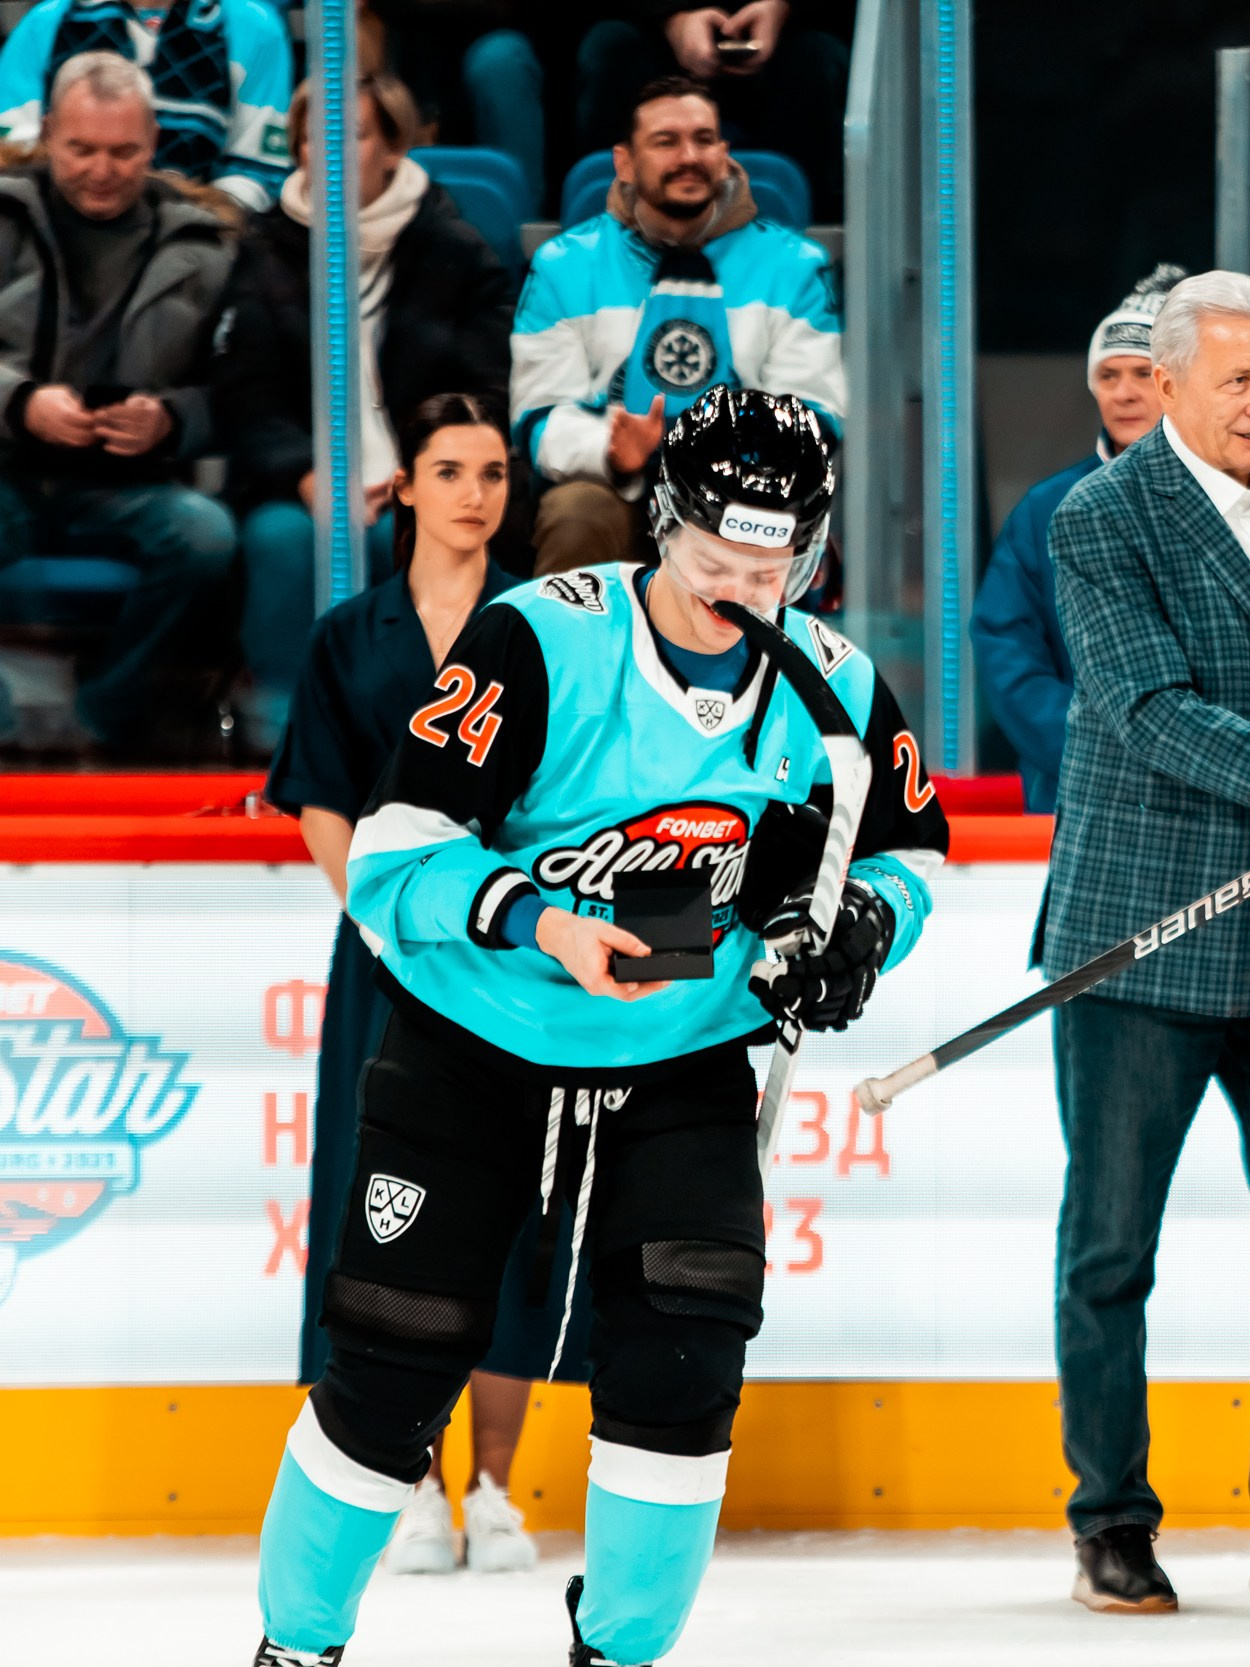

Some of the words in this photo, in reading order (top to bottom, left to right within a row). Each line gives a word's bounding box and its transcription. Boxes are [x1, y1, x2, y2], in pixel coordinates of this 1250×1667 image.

[725, 517, 789, 538] согаз
[409, 664, 505, 768] 24
[656, 817, 738, 838] FONBET
[587, 905, 609, 919] ST.
